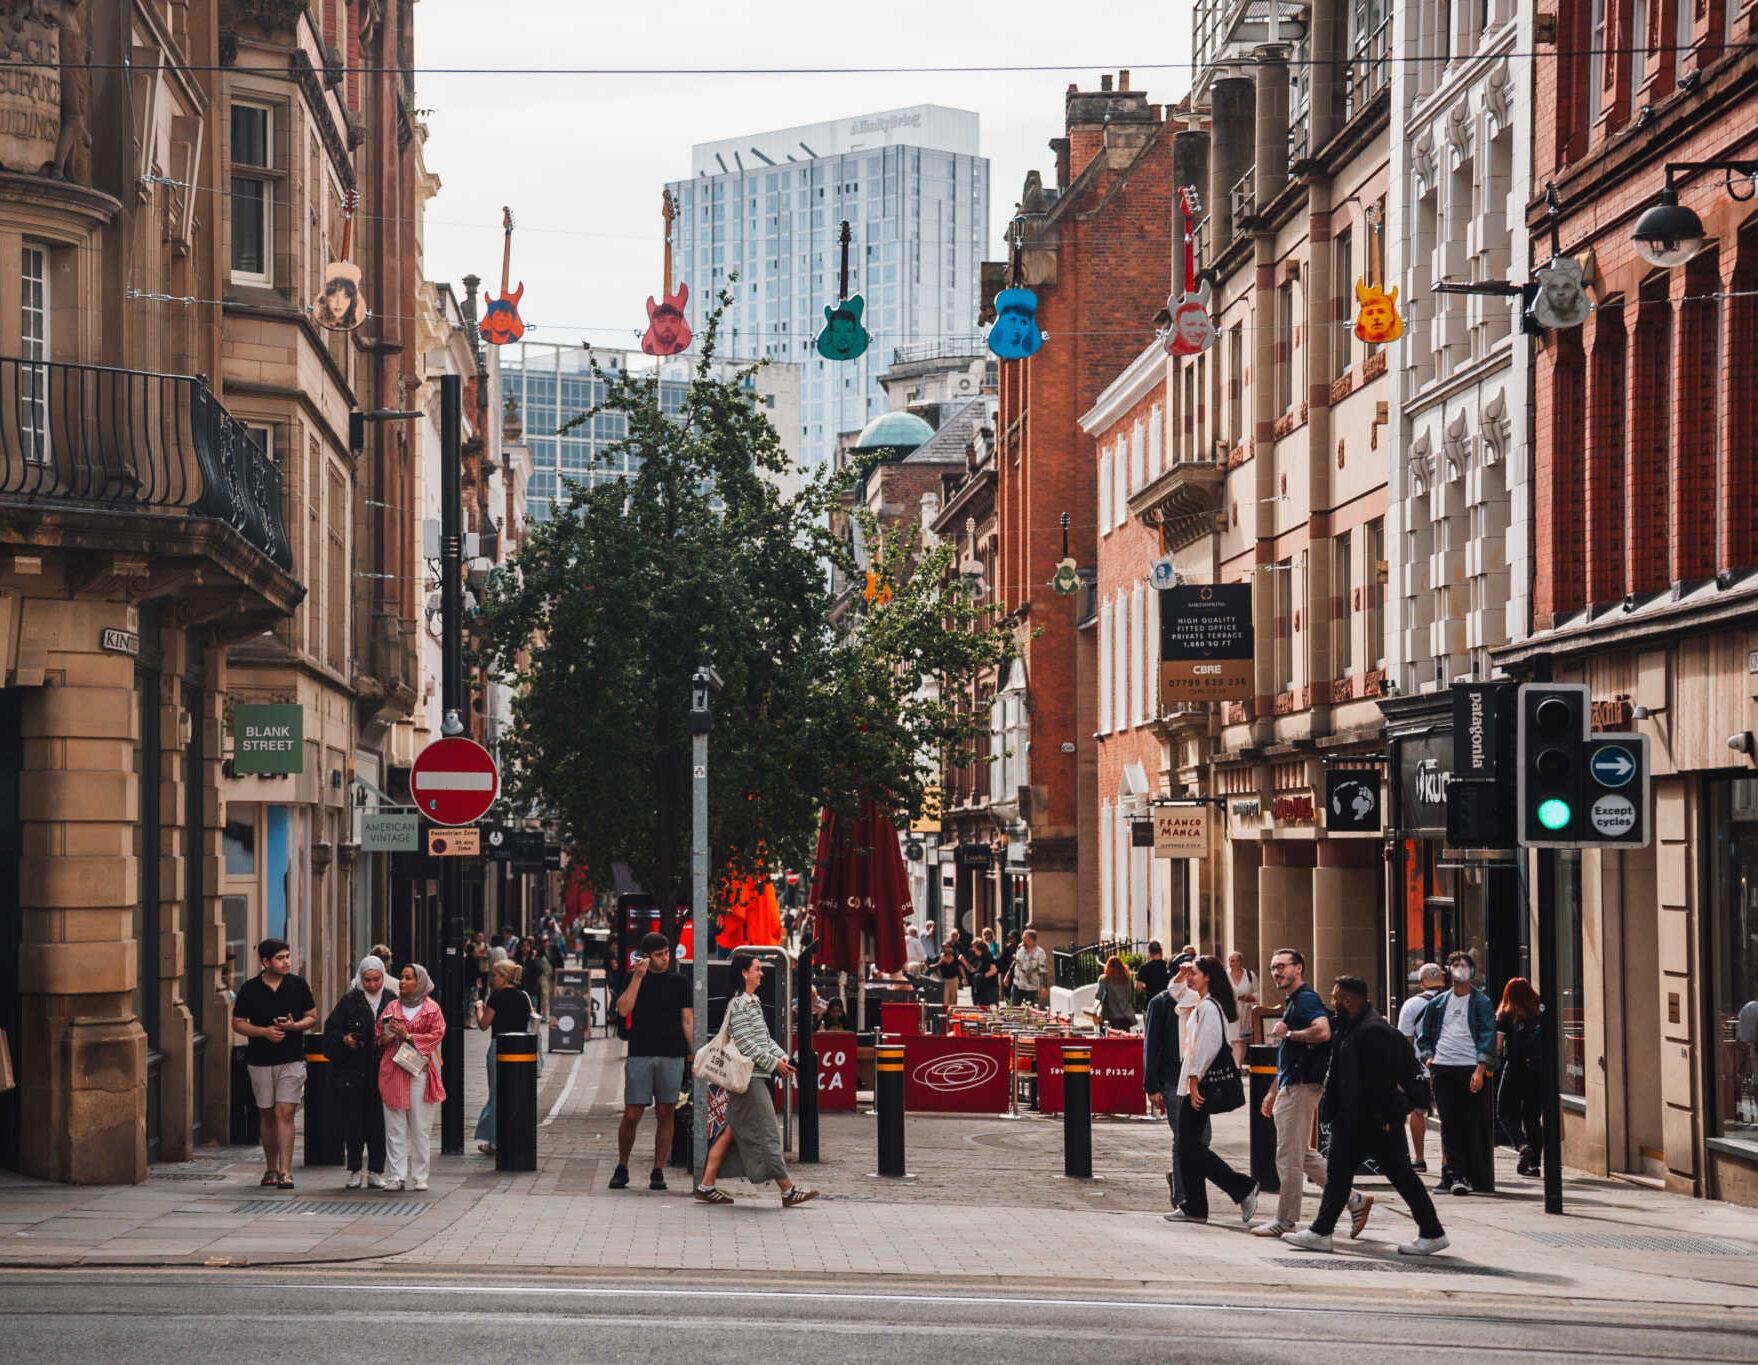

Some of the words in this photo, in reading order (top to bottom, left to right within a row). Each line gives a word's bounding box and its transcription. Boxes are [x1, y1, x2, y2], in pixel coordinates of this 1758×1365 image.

[1201, 616, 1236, 624] QUALITY
[1193, 664, 1222, 675] CBRE
[1591, 701, 1622, 733] agonia
[245, 726, 290, 737] BLANK
[1469, 692, 1485, 769] patagonia
[242, 740, 294, 751] STREET
[1594, 806, 1633, 818] Except
[365, 823, 415, 832] AMERICAN
[1159, 819, 1201, 827] FRANCO
[1597, 816, 1631, 828] cycles
[370, 833, 411, 842] VINTAGE
[1161, 828, 1200, 837] MANCA
[1050, 1066, 1101, 1076] SOUGH
[1105, 1067, 1135, 1076] PIZZA
